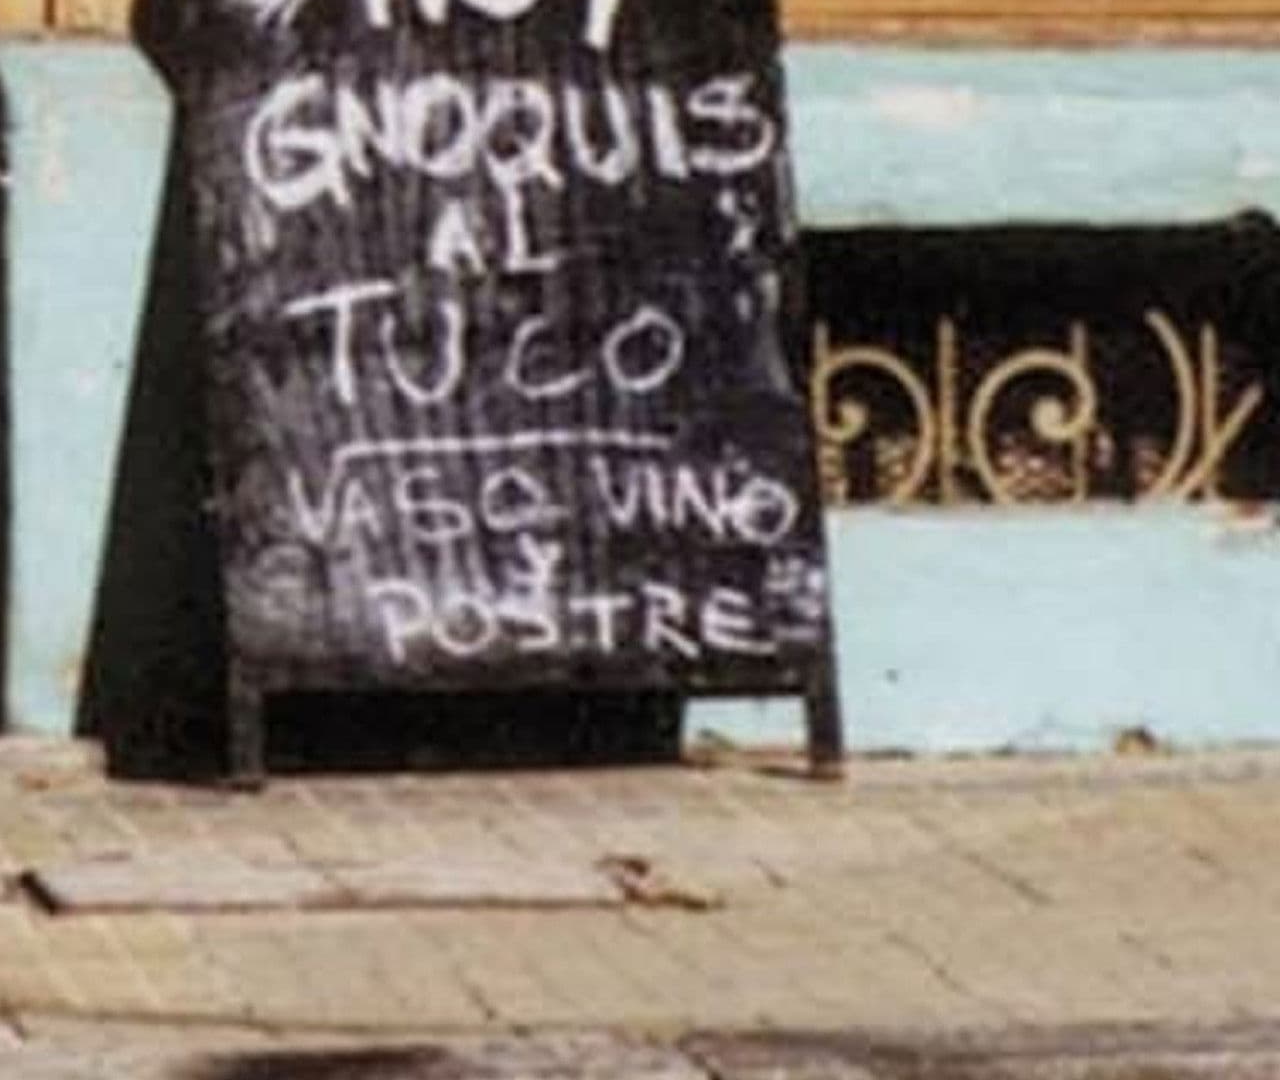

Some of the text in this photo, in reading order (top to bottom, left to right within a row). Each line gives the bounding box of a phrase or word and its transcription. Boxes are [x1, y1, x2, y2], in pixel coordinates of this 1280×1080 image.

[248, 71, 776, 210] GNOQUIS
[428, 180, 555, 273] AL
[285, 281, 684, 405] TUCO
[289, 455, 798, 546] VASO VINO
[368, 581, 774, 660] POSTRE
